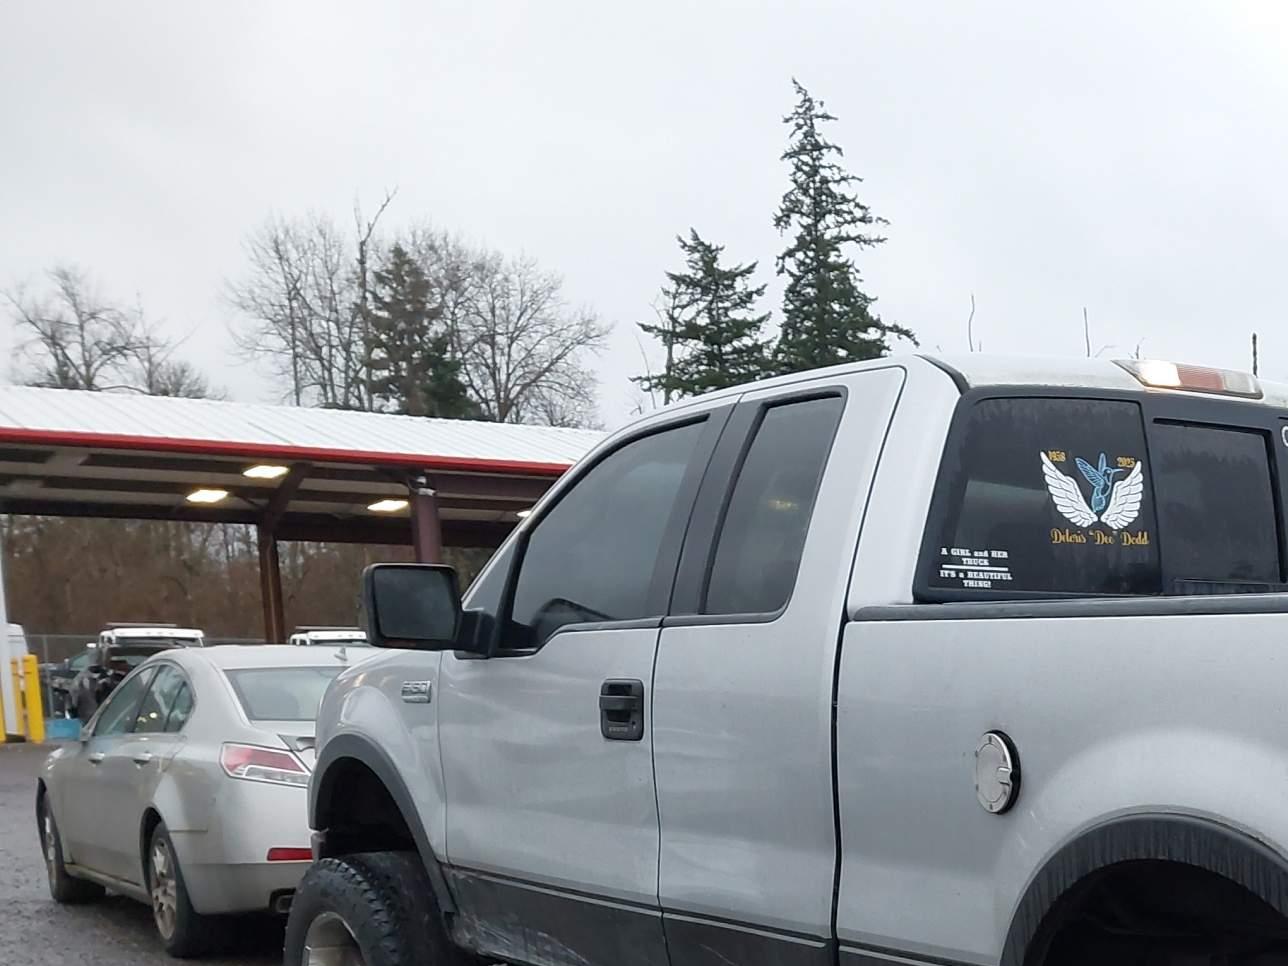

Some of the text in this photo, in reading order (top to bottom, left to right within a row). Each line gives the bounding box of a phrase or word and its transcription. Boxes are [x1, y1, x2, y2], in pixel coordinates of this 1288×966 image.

[941, 547, 948, 555] A
[950, 548, 971, 556] GIRL
[990, 550, 1009, 558] HER
[961, 557, 990, 566] TRUCK
[939, 569, 957, 578] IT'S
[966, 571, 1013, 580] BEAUTIFUL
[962, 579, 992, 588] THING!
